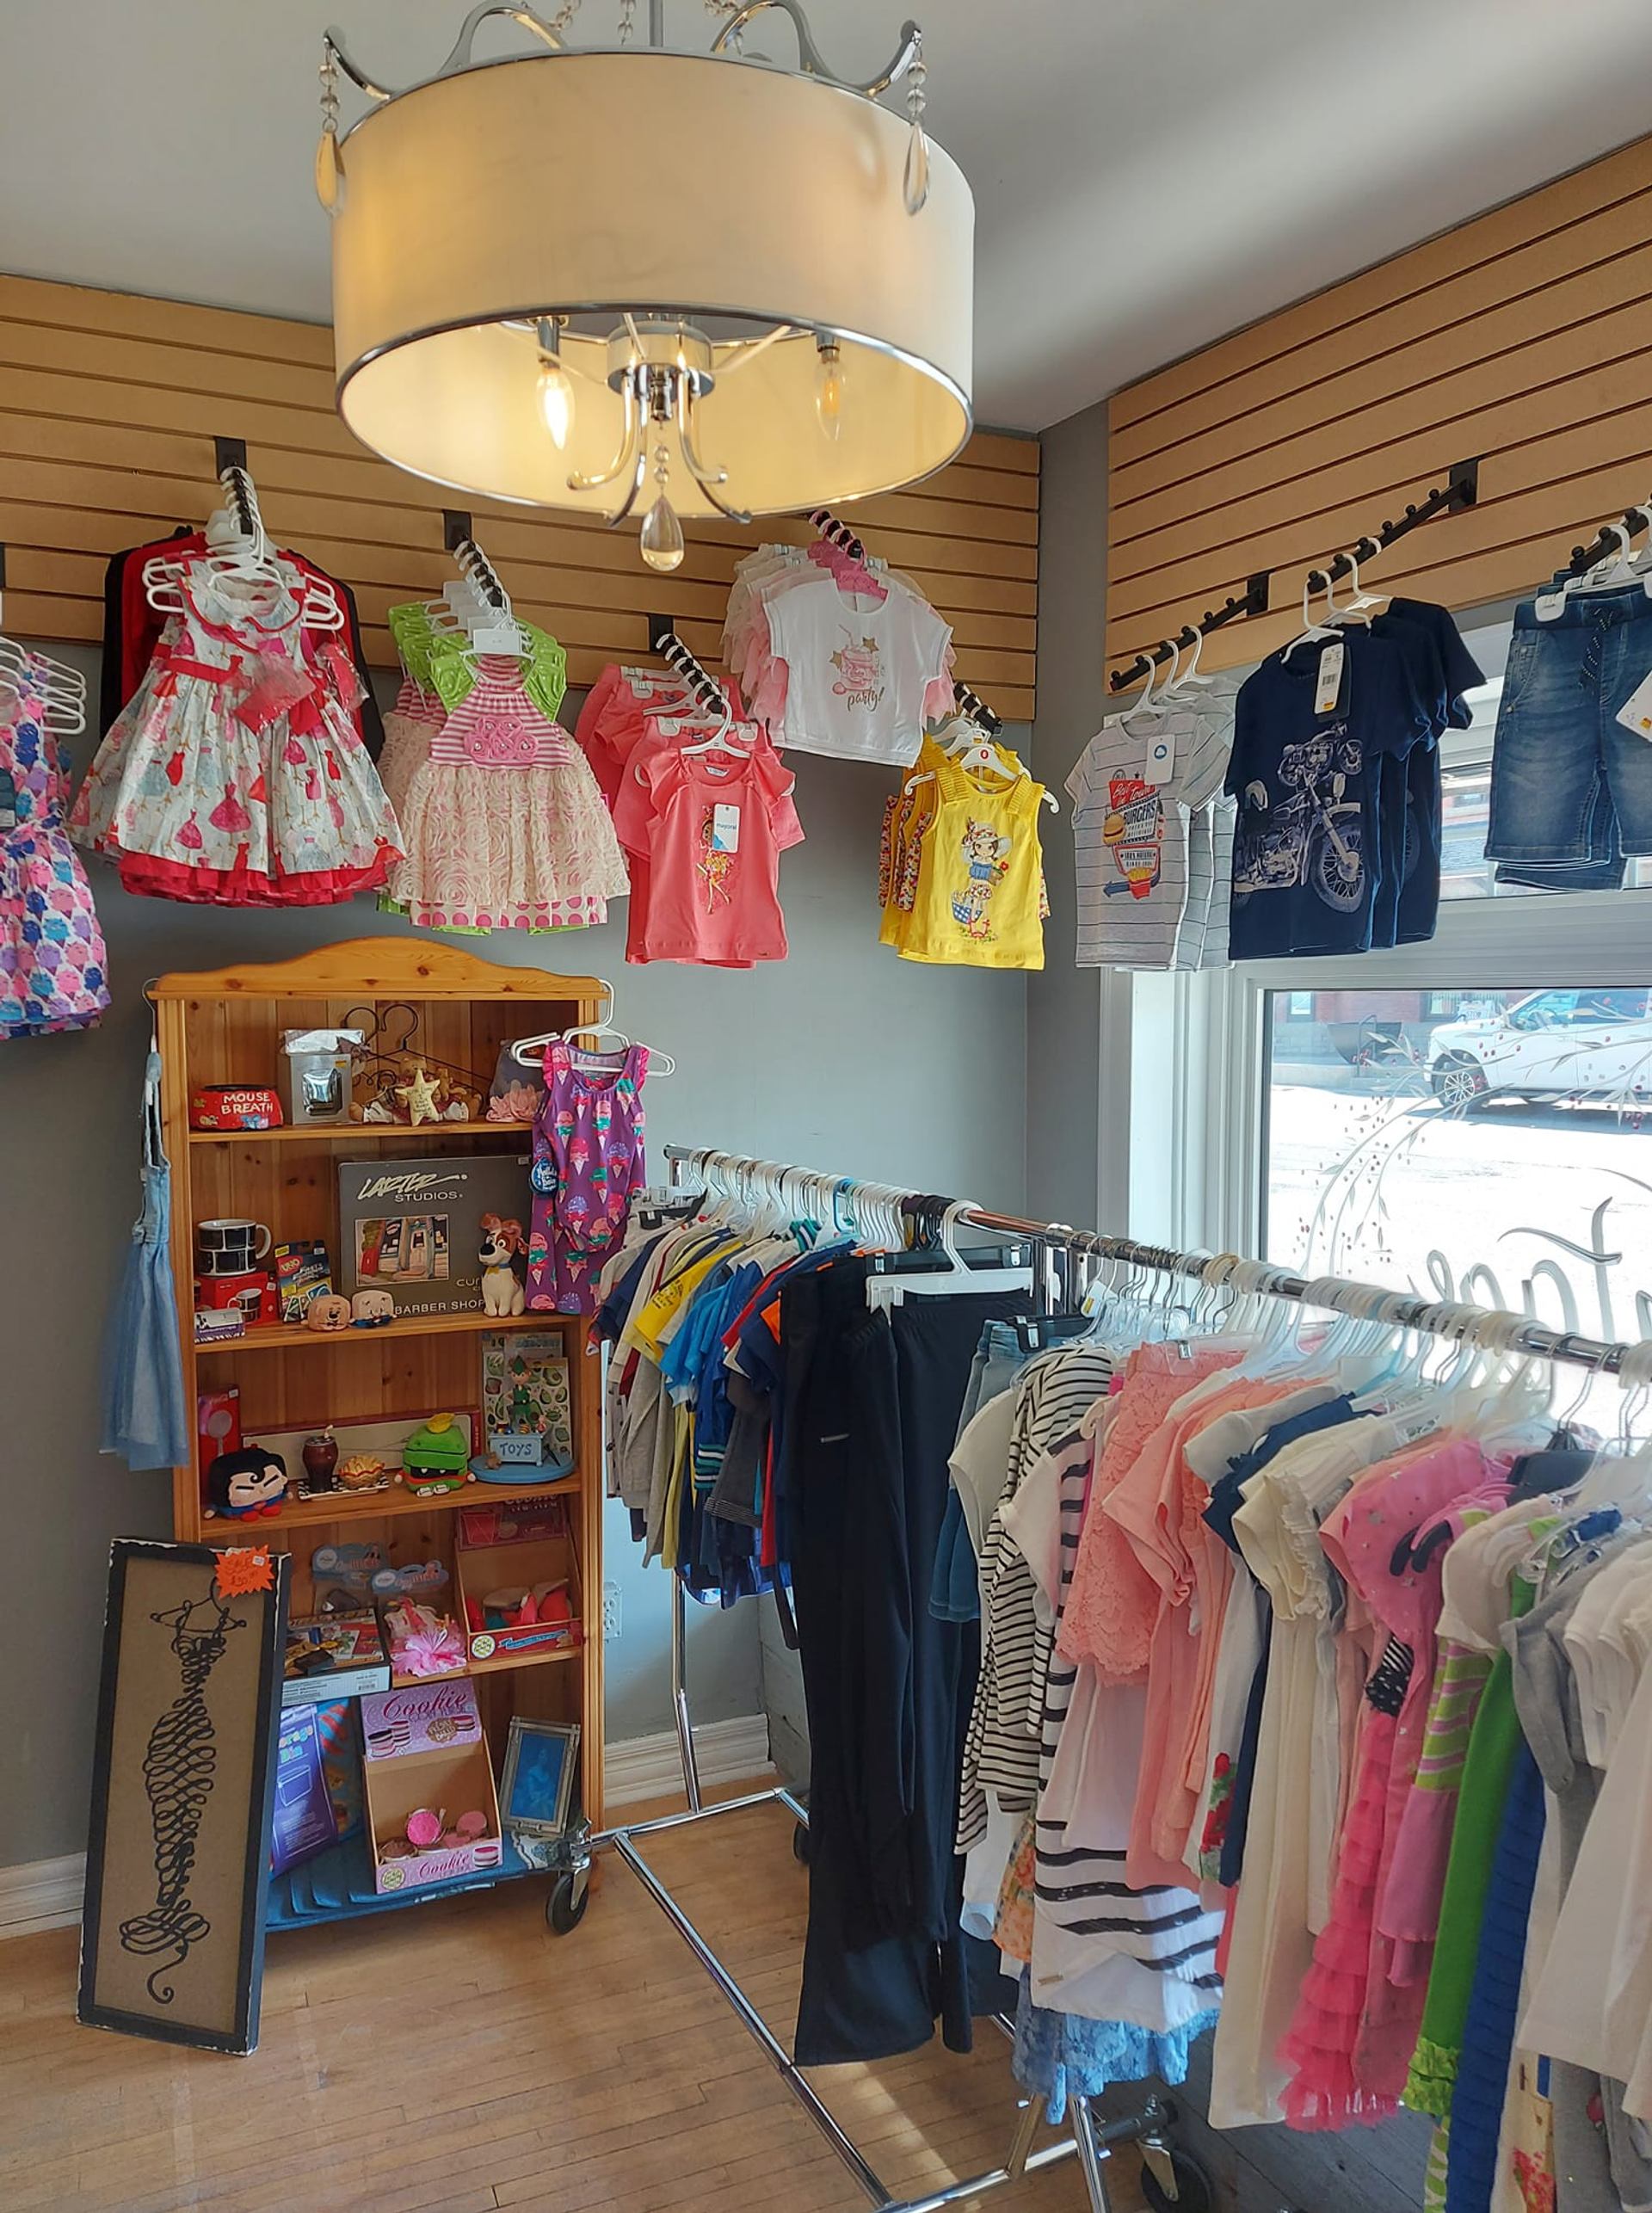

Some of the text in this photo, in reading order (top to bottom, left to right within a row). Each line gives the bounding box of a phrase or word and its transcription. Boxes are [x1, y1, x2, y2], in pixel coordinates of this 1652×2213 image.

[847, 687, 885, 712] party!
[1125, 800, 1156, 824] BURGERS
[223, 1092, 270, 1103] MOUSE
[221, 1102, 274, 1115] BREATH
[394, 1191, 458, 1203] STUDIOS
[280, 1259, 300, 1272] UNO
[395, 1299, 485, 1315] BARBER SHOP
[499, 1442, 533, 1457] TOYS
[383, 1686, 467, 1721] Cookie
[279, 1725, 313, 1748] orage
[280, 1744, 304, 1763] Bin
[419, 1851, 470, 1878] Cookie
